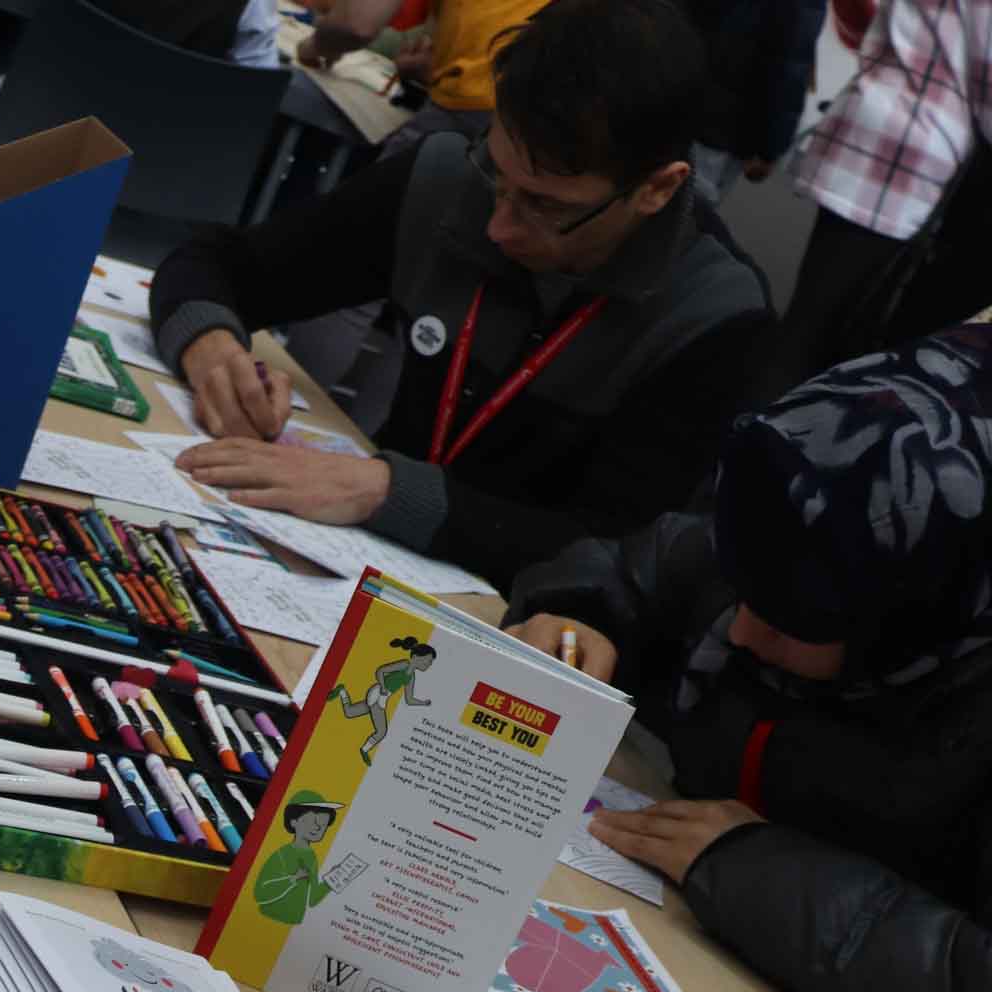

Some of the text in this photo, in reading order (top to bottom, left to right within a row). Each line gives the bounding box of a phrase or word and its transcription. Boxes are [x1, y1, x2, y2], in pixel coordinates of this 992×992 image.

[484, 690, 547, 727] BE YOUR
[471, 709, 540, 749] BEST YOU
